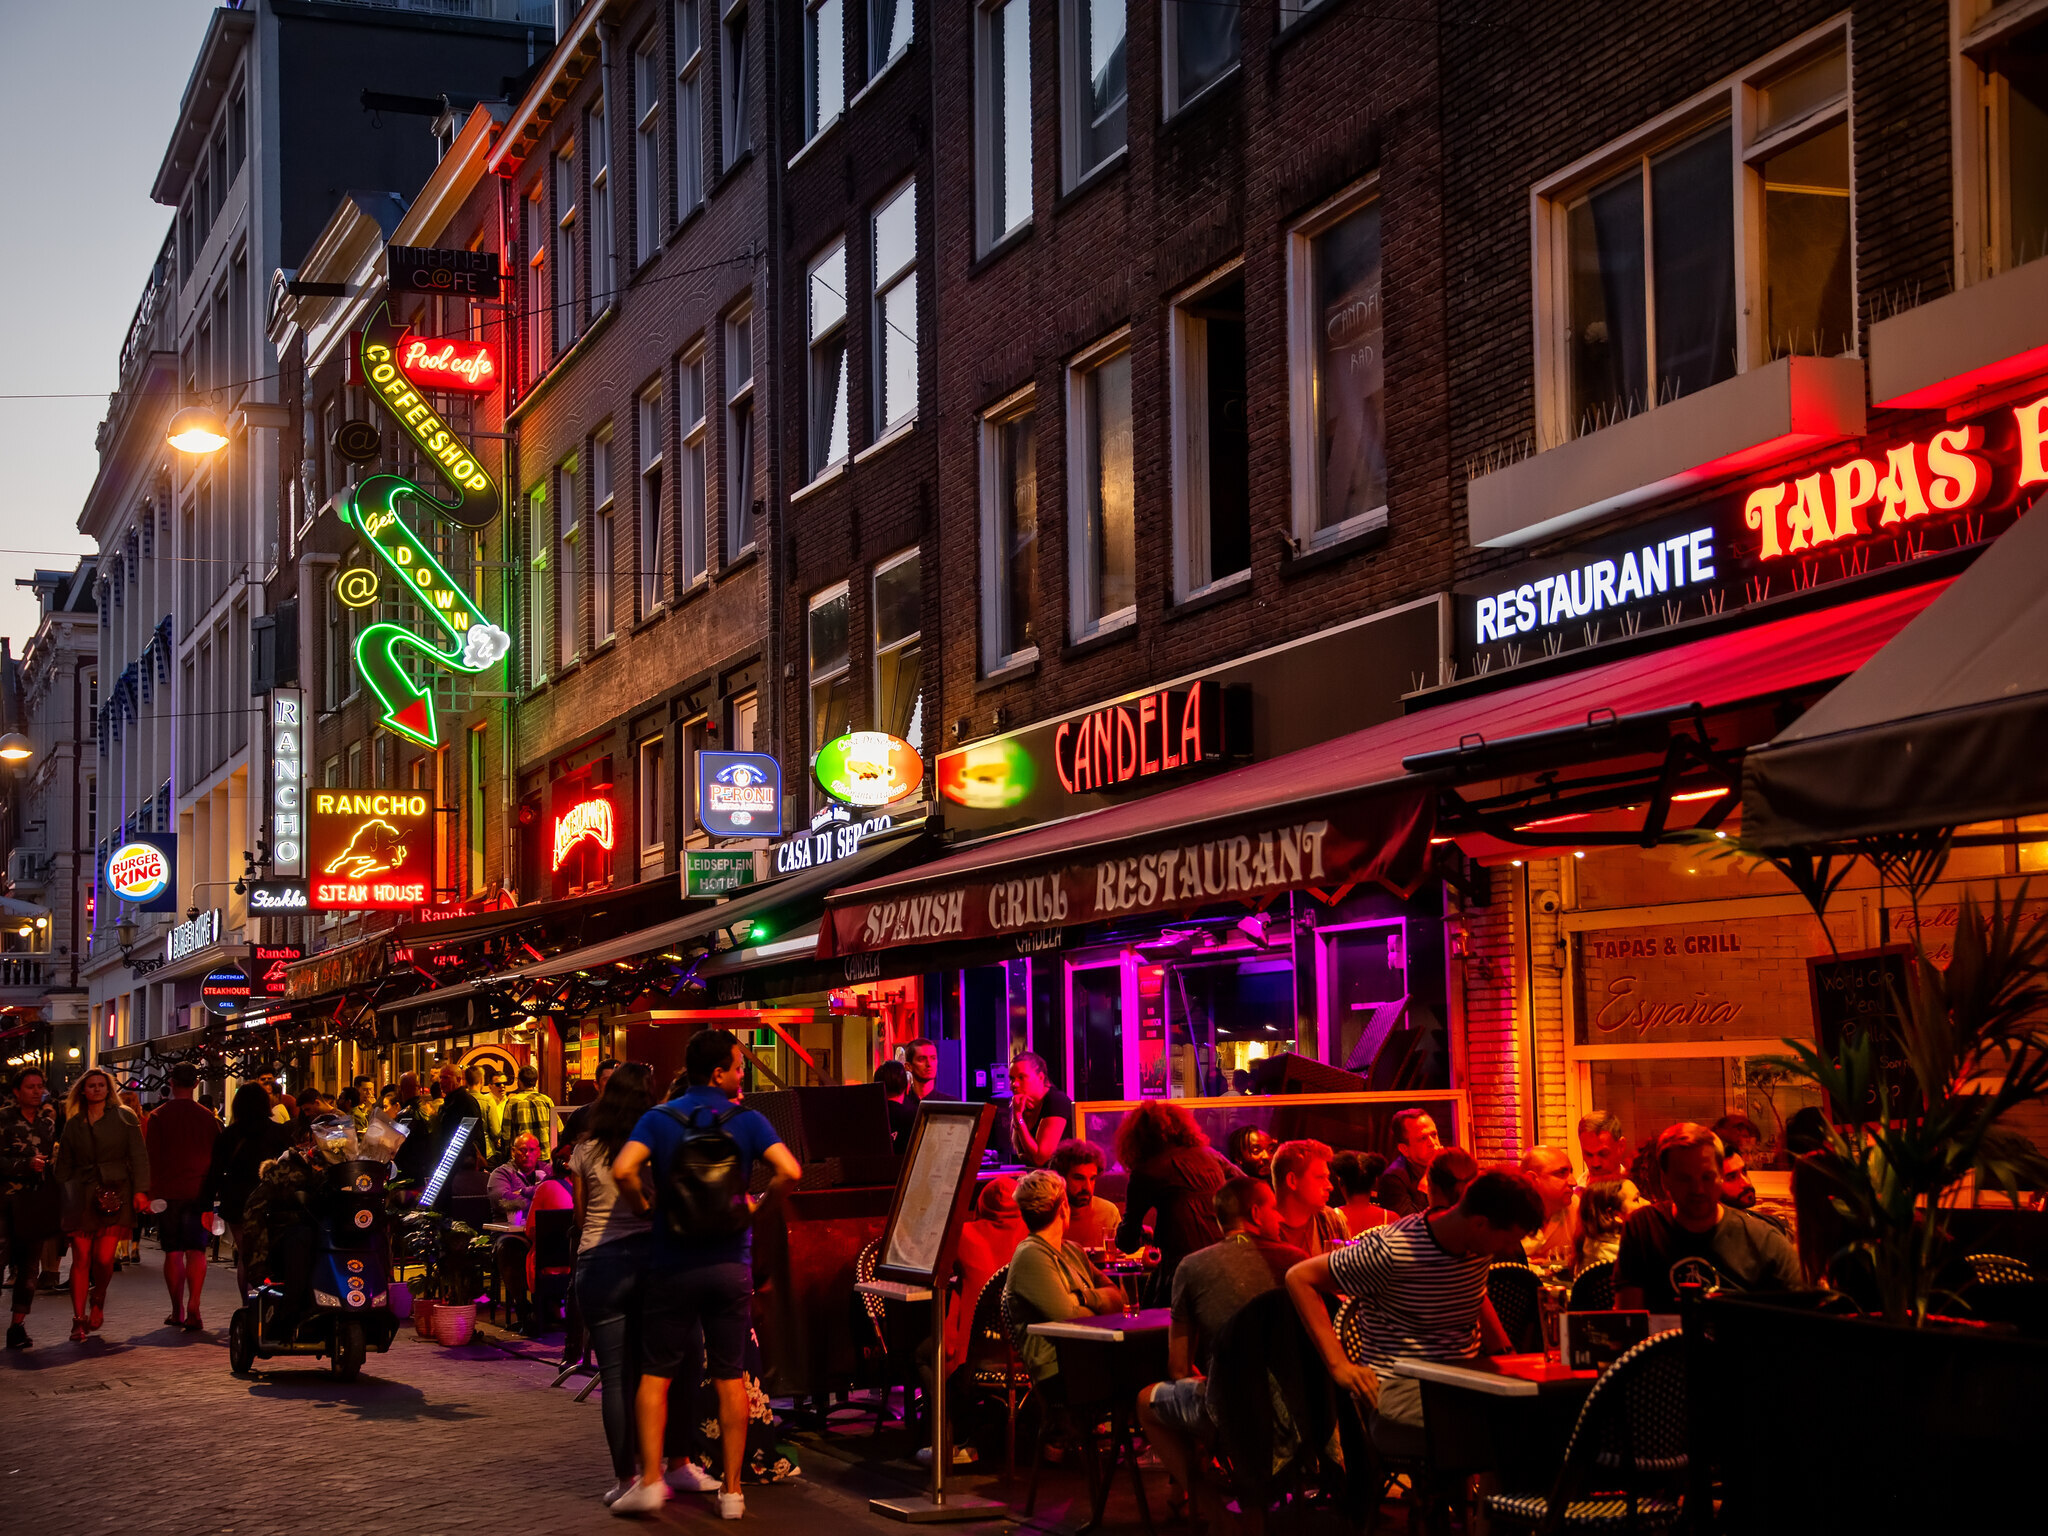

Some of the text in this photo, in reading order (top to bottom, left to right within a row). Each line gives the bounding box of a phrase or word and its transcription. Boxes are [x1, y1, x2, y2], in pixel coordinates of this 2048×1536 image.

[405, 341, 493, 384] Pool cafe
[366, 344, 488, 493] COFFEESHOP
[1744, 425, 1979, 562] TAPAS
[365, 508, 469, 632] Get DOWN
[1476, 526, 1717, 645] RESTAURANTE
[1055, 680, 1202, 795] CANDELA
[275, 699, 299, 864] RANCHO
[710, 784, 774, 804] PERONI
[316, 794, 427, 816] RANCHO
[112, 853, 159, 875] BURGER
[688, 858, 753, 871] LEIDSEPLEIN
[777, 837, 812, 873] CASA
[816, 831, 833, 865] DI
[115, 863, 161, 890] KING
[700, 877, 739, 891] HOTEL
[863, 819, 1330, 945] SPANISH GRILL RESTAURANT
[318, 884, 425, 902] STEAK HOUSE
[256, 947, 301, 959] Rancho
[1594, 933, 1741, 959] TAPAS & GRILL
[843, 951, 881, 981] CANDELA
[203, 987, 250, 995] STEAKHOUSE
[1596, 975, 1743, 1037] España
